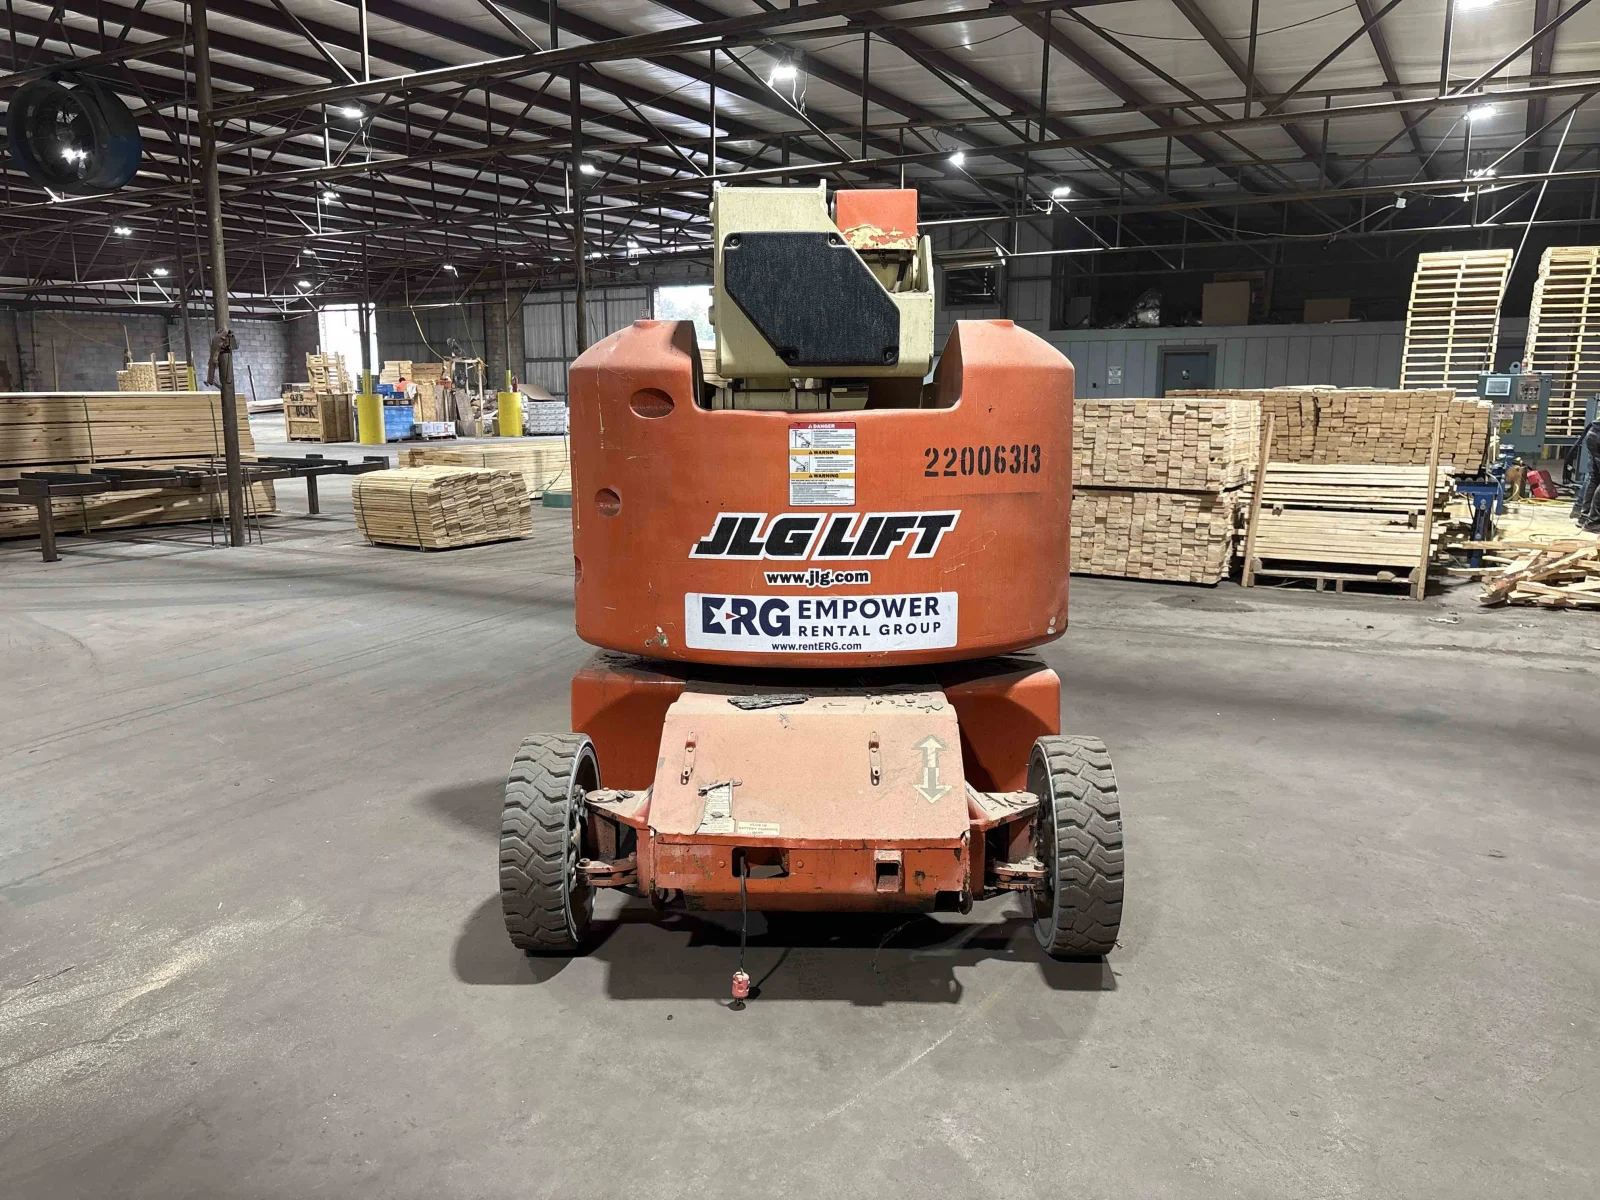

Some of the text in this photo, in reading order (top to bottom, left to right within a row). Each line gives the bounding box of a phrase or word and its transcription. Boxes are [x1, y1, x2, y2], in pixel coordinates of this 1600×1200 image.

[924, 444, 1041, 477] 22006313
[691, 512, 958, 558] JLG LIFT
[766, 569, 869, 586] www.jlg.com
[702, 596, 791, 637] ERG
[799, 596, 940, 620] EMPOWER
[799, 622, 942, 637] RENTAL GROUP
[771, 641, 862, 651] www.rentERG.com
